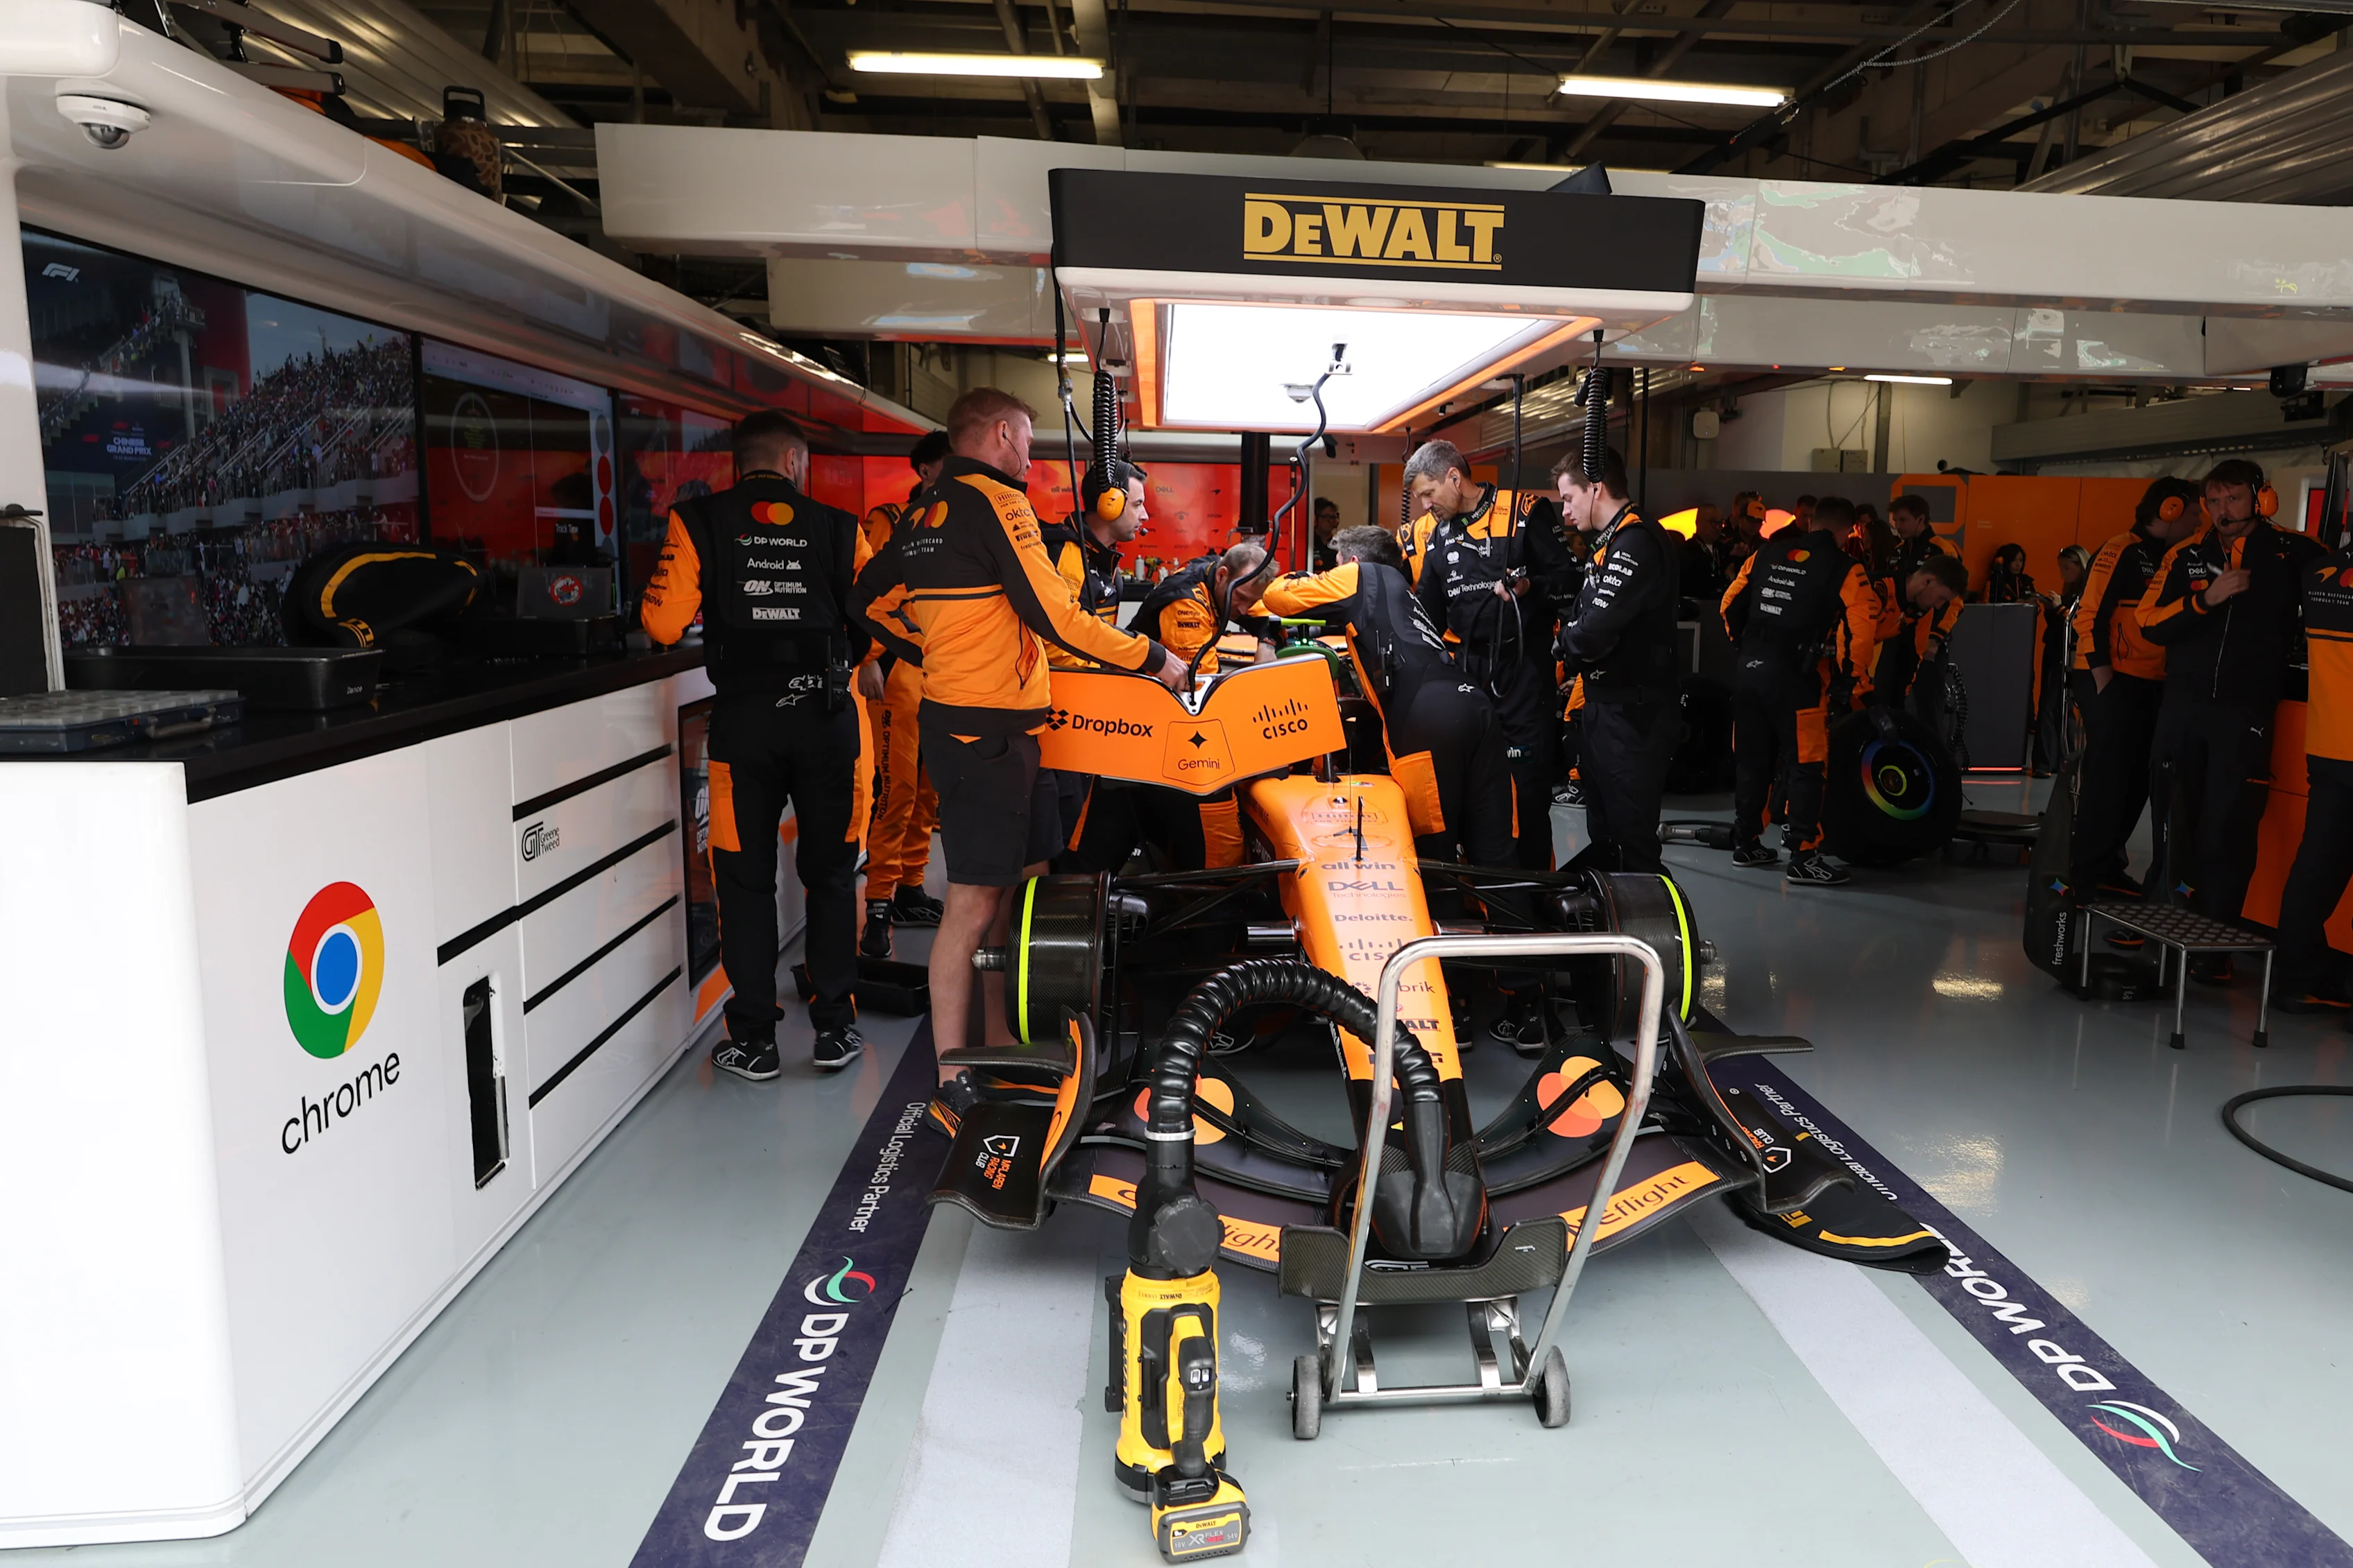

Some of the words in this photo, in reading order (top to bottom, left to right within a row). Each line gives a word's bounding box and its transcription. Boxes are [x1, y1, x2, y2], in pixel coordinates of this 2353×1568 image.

[556, 524, 567, 533] Track
[568, 524, 579, 533] Time
[754, 536, 767, 545] DP
[769, 537, 807, 547] WORLD
[747, 557, 784, 569] Android
[1608, 563, 1633, 576] ECOLAB
[743, 579, 773, 595] ON
[1603, 574, 1622, 587] okta
[1072, 714, 1154, 738] Dropbox
[1263, 718, 1308, 739] CISCO
[882, 731, 891, 774] OPTIMUM
[1178, 758, 1220, 771] Gemini
[540, 827, 559, 843] Greene
[541, 833, 560, 854] Tweed
[1328, 881, 1404, 891] DELL
[2051, 911, 2067, 965] freshworks
[282, 1052, 400, 1155] chrome
[1754, 1083, 1801, 1116] Partner
[893, 1102, 926, 1135] Official
[1753, 1128, 1774, 1144] CLUB
[871, 1135, 913, 1184] Logistics
[975, 1152, 989, 1169] CLUB
[984, 1156, 1000, 1180] RACING
[848, 1185, 891, 1233] Partner
[1919, 1222, 2046, 1335] WORL
[792, 1313, 849, 1362] DP
[2028, 1338, 2117, 1392] DP
[703, 1365, 827, 1542] WORLD
[1188, 1534, 1206, 1546] XR
